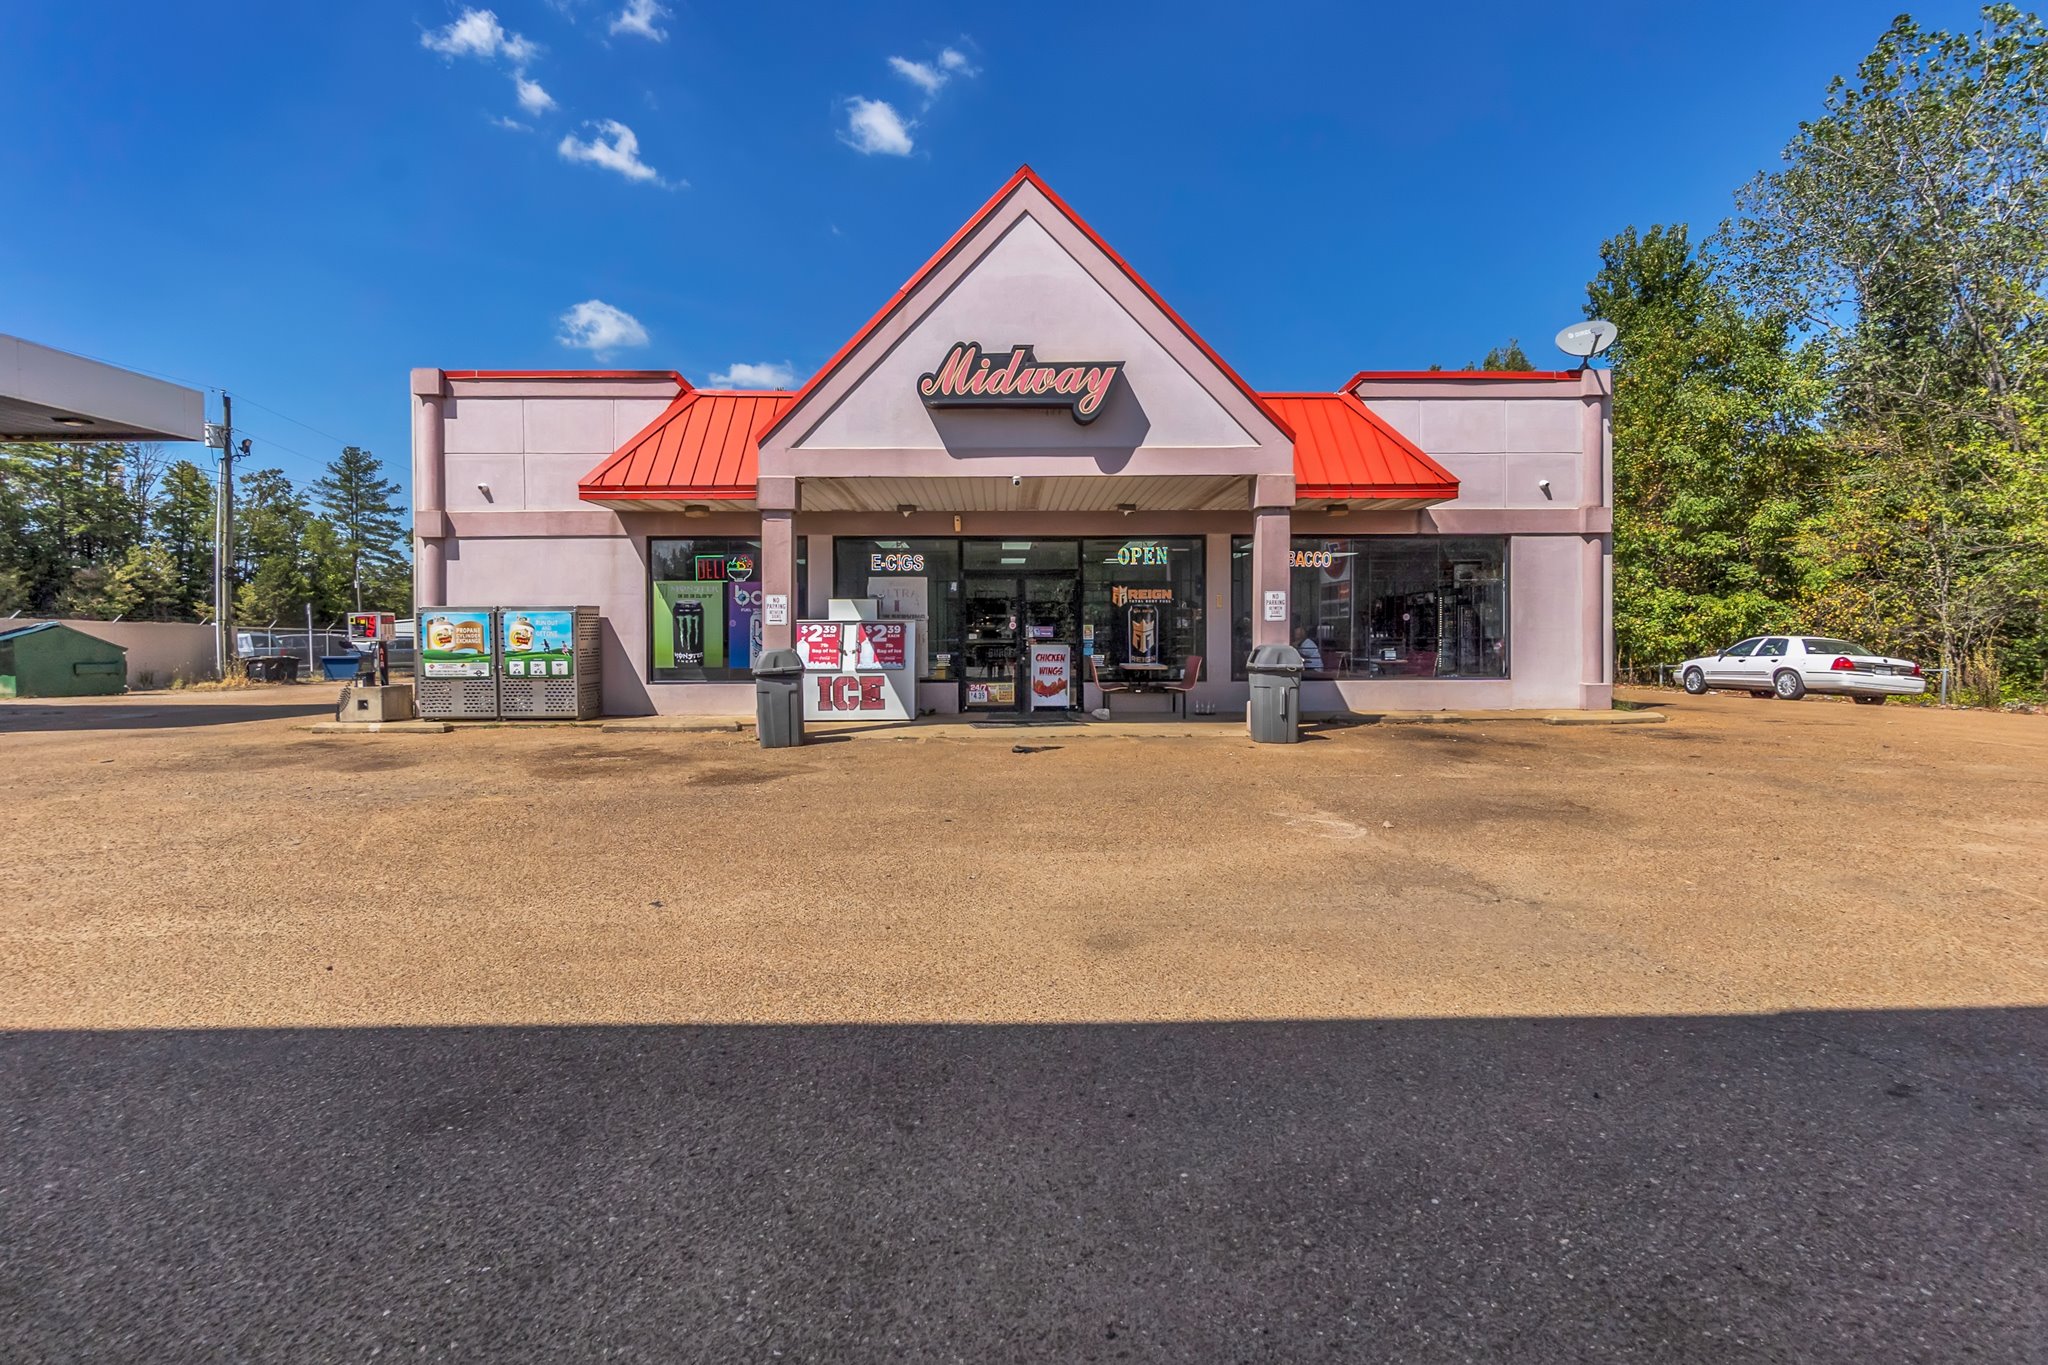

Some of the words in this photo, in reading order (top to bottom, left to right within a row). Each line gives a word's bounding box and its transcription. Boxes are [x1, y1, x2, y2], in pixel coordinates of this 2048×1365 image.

[921, 346, 1118, 415] Midway
[871, 554, 924, 571] E-CIGS
[1118, 547, 1168, 565] OPEN
[1289, 551, 1332, 567] BACCO
[697, 560, 725, 579] DELI
[1128, 589, 1172, 600] REIGN
[1039, 667, 1063, 675] WINGS
[817, 676, 885, 711] ICE
